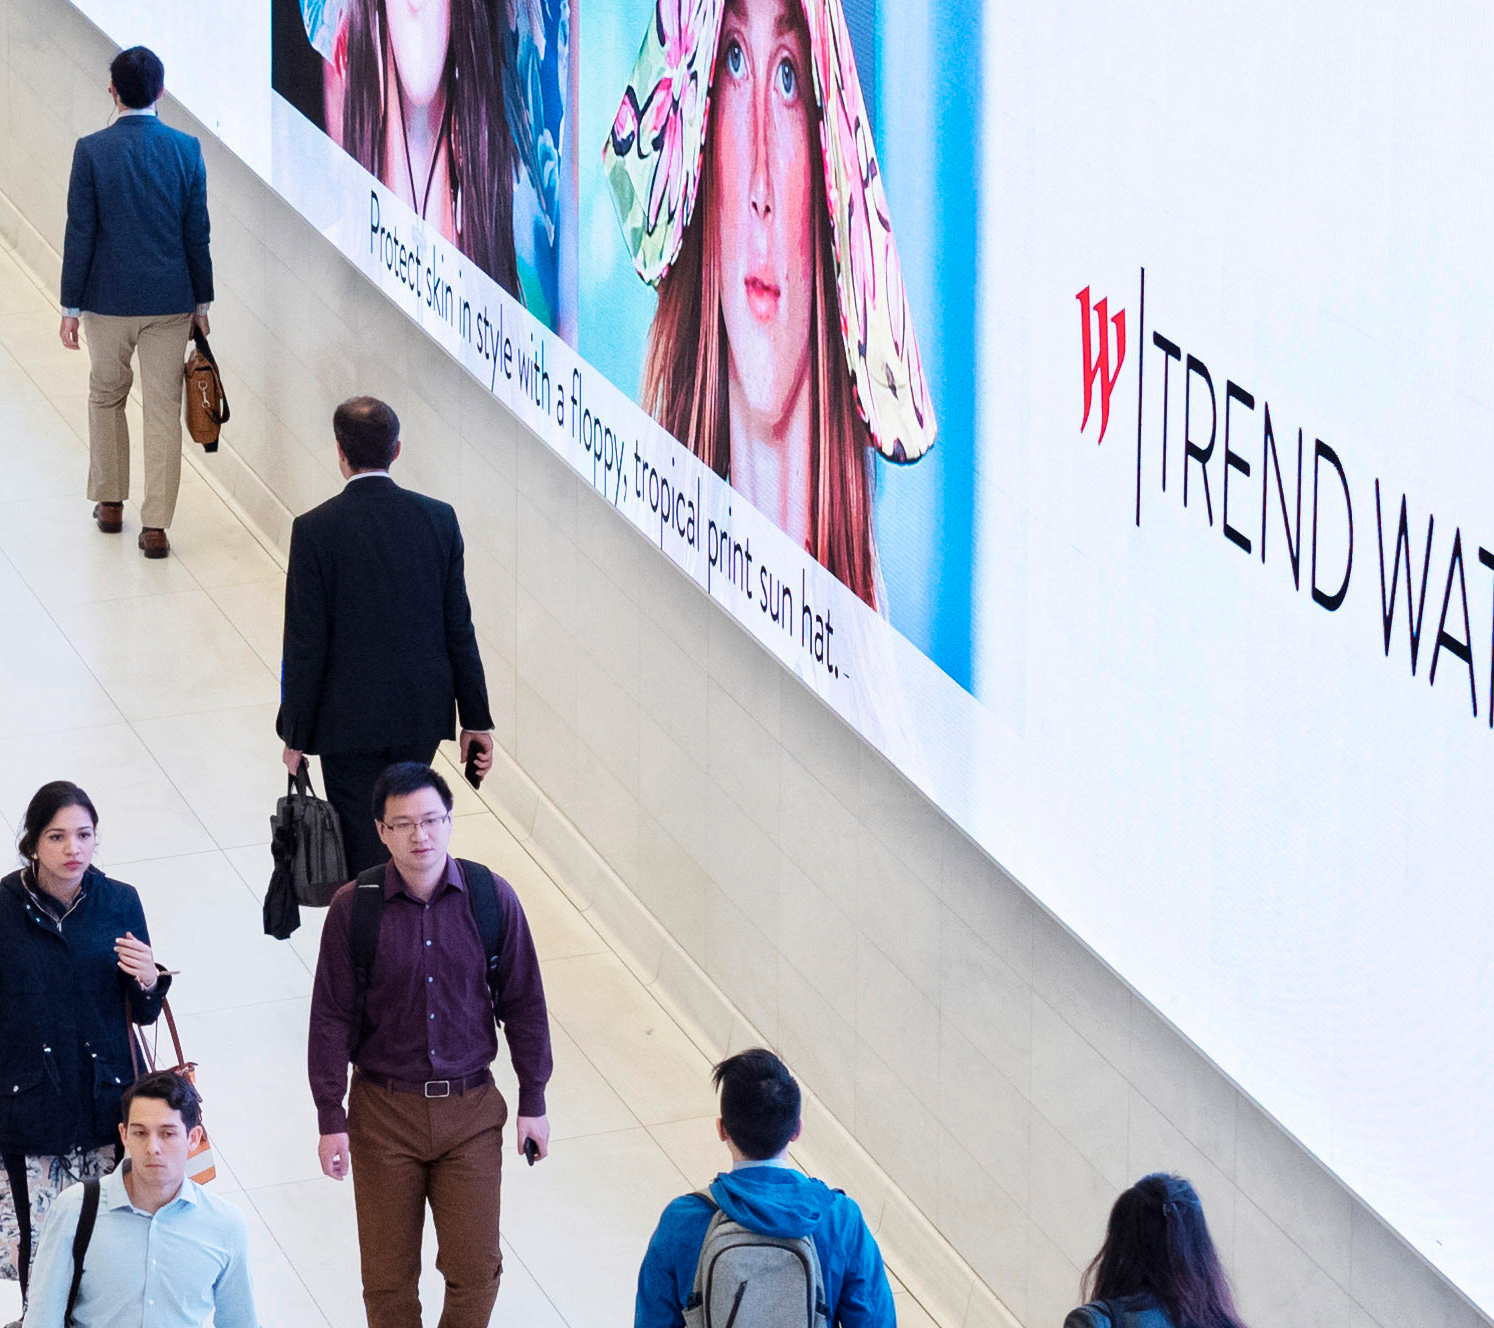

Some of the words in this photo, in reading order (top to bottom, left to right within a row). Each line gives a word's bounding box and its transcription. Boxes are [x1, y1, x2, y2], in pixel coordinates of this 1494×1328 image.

[370, 190, 421, 297] Protect
[426, 244, 454, 327] skin
[459, 269, 471, 344] in
[476, 303, 513, 393] style
[517, 332, 551, 416] with
[556, 383, 565, 427] a
[571, 368, 628, 507] floppy,
[634, 439, 701, 550] tropical
[708, 506, 753, 595] print
[759, 565, 793, 637] sun
[801, 568, 839, 679] hat.
[1152, 330, 1354, 612] TREND
